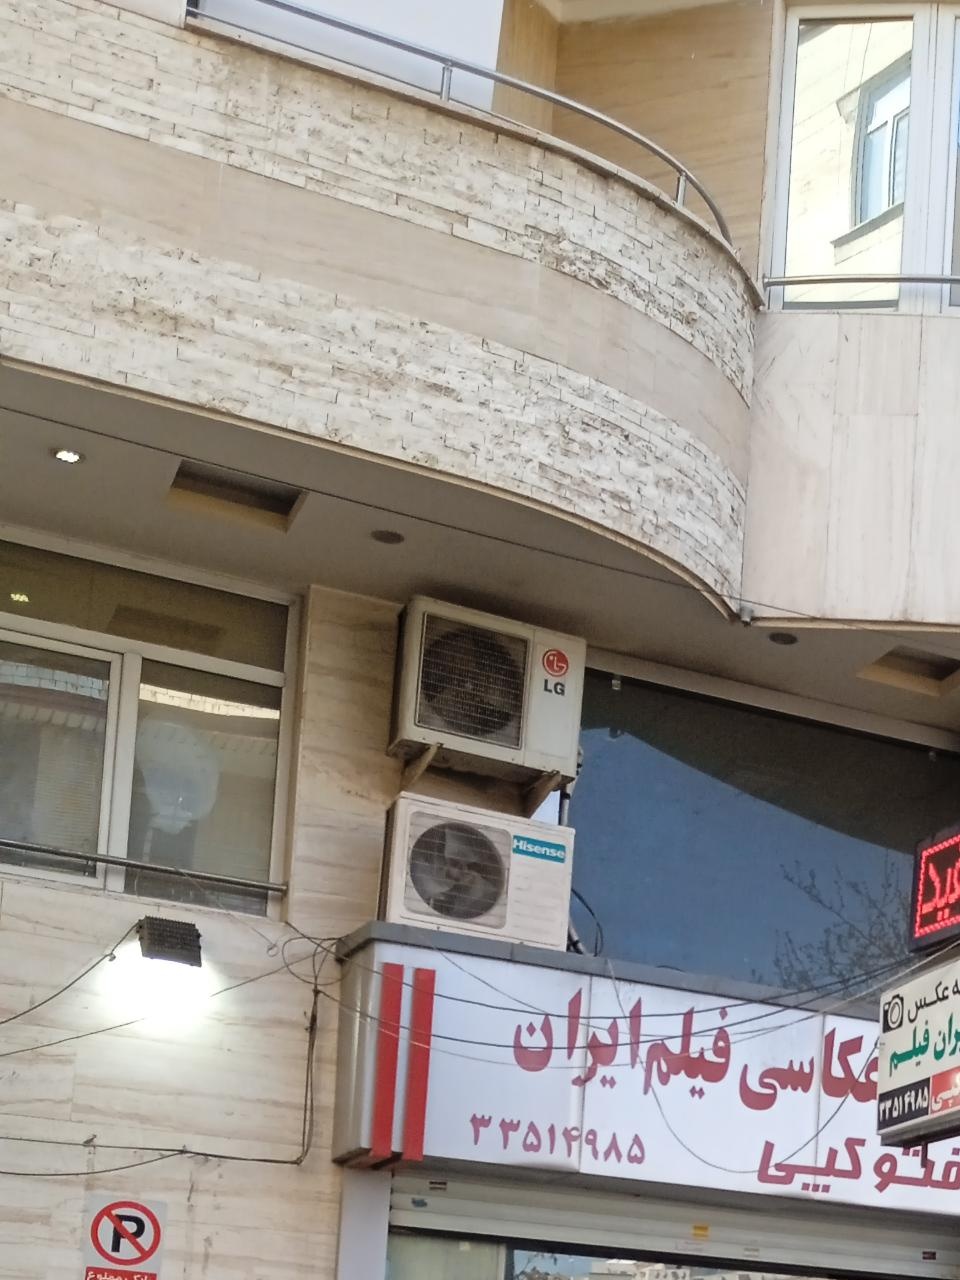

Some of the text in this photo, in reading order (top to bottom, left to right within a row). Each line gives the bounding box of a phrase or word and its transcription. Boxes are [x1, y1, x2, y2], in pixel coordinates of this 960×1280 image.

[543, 679, 566, 696] LG
[513, 835, 566, 859] Hisense
[907, 981, 949, 1024] عکس
[513, 988, 642, 1088] ایران
[643, 1007, 731, 1100] فیلم
[889, 1020, 930, 1077] فیلم
[879, 1085, 929, 1122] ۳۳۵۱۴۹۸۵
[470, 1113, 646, 1165] ۳۳۵۱۴۹۸۵
